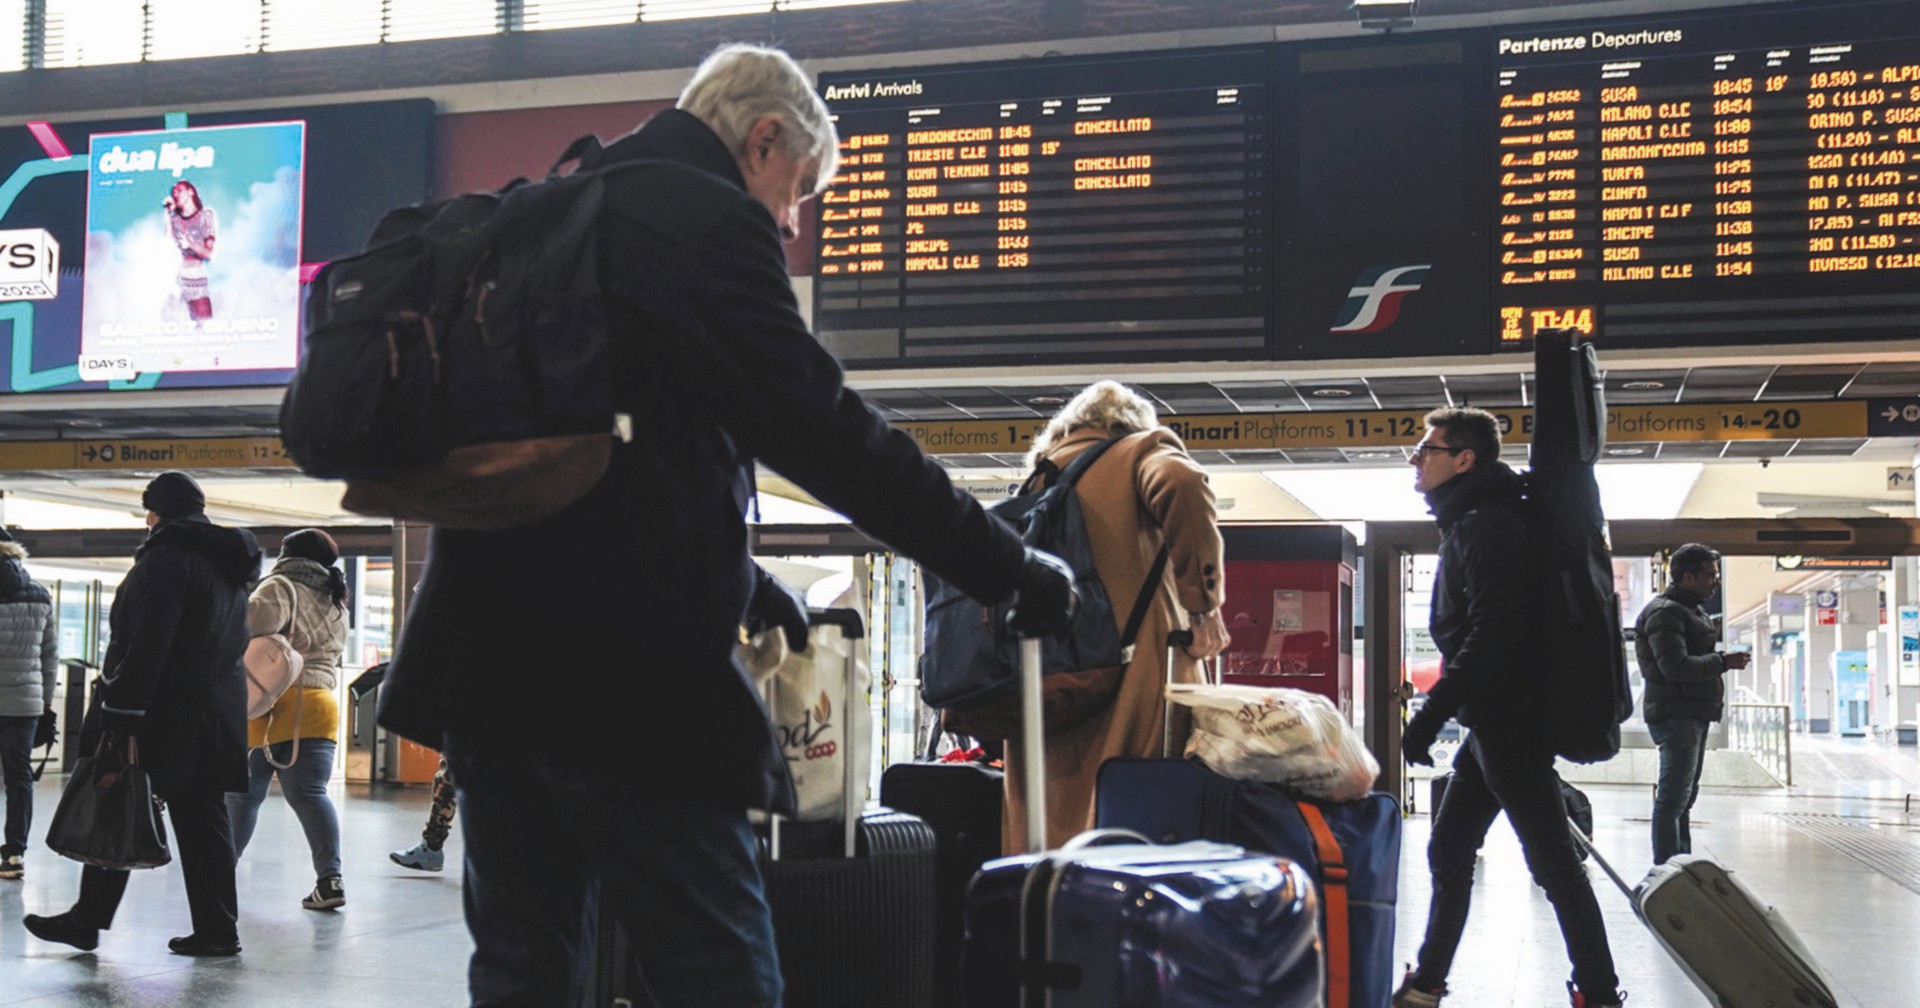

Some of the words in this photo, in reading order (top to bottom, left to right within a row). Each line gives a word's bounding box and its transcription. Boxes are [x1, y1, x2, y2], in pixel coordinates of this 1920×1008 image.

[1499, 36, 1586, 54] Partenze
[1592, 29, 1681, 48] Departures
[825, 83, 869, 99] Arrivi
[873, 80, 922, 97] Arrivals
[1601, 86, 1638, 103] SUSA
[1713, 78, 1753, 95] 10:45
[1601, 105, 1652, 122] MILANO
[1713, 98, 1752, 115] 10:54
[999, 125, 1032, 140] 10:45
[1074, 118, 1152, 135] CANCELLATO
[1602, 125, 1653, 142] NAPOLI
[1714, 118, 1752, 135] 11:00
[908, 147, 955, 162] TRIESTE
[998, 143, 1030, 157] 11:00
[1714, 139, 1749, 154] 11:15
[99, 146, 156, 173] dua
[158, 142, 214, 177] lipa
[907, 166, 938, 181] ROMA
[943, 164, 990, 178] TERMINI
[999, 162, 1030, 176] 11:05
[1074, 155, 1152, 172] CANCELLATO
[907, 185, 938, 199] SUSA
[998, 180, 1028, 194] 11:15
[1074, 174, 1152, 190] CANCELLATO
[906, 203, 949, 216] MILANO
[998, 199, 1027, 212] 11:15
[1716, 200, 1752, 215] 11:30
[998, 217, 1027, 231] 11:15
[1716, 221, 1753, 235] 11:30
[1603, 247, 1640, 261] SUSA
[1716, 241, 1753, 256] 11:45
[906, 256, 948, 271] NAPOLI
[998, 253, 1029, 267] 11:35
[1603, 266, 1654, 280] MILANO
[1716, 261, 1752, 276] 11:54
[1244, 421, 1335, 440] Platforms
[1606, 411, 1705, 434] Platforms
[1721, 408, 1800, 430] 14-20
[914, 427, 998, 447] Platforms
[121, 443, 174, 461] Binari
[177, 443, 244, 461] Platforms
[804, 740, 837, 761] coop
